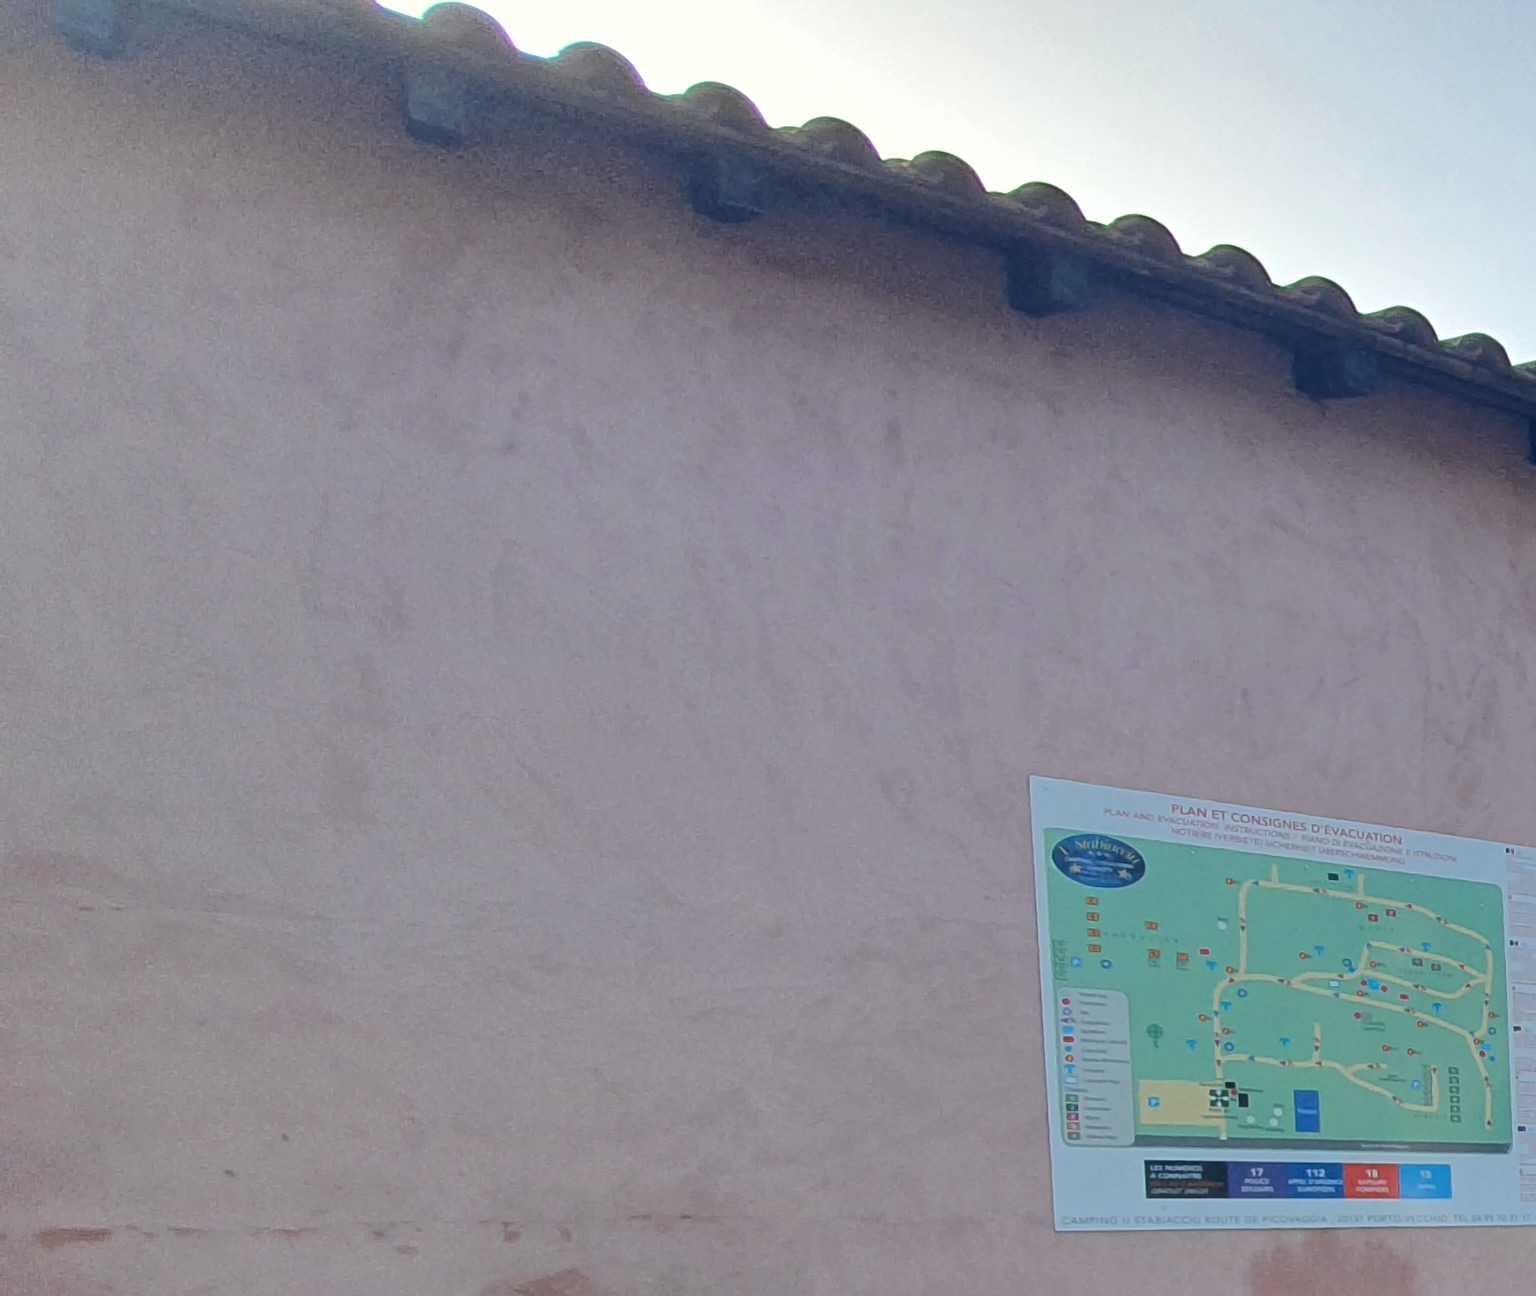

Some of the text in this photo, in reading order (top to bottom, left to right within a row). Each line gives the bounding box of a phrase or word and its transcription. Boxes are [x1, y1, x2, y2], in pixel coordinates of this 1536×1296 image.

[1103, 808, 1130, 818] PLAN
[1133, 812, 1155, 821] AND
[1157, 815, 1220, 830] EVACUATION
[1224, 824, 1292, 840] INSTRUCTIONS
[1171, 803, 1403, 845] PLAN ET CONSIGNES D'ÉVACUATION
[1250, 1167, 1264, 1177] 17
[1305, 1168, 1326, 1178] 112
[1364, 1168, 1379, 1178] 18
[1061, 1215, 1118, 1226] CAMPING
[1123, 1215, 1131, 1225] U
[1134, 1215, 1201, 1225] STABIACCIU
[1204, 1215, 1241, 1225] ROUTE
[1244, 1215, 1257, 1224] DE
[1262, 1215, 1328, 1224] PICOVAGGIA
[1367, 1214, 1400, 1224] PORTO
[1405, 1214, 1448, 1223] VECCHIO
